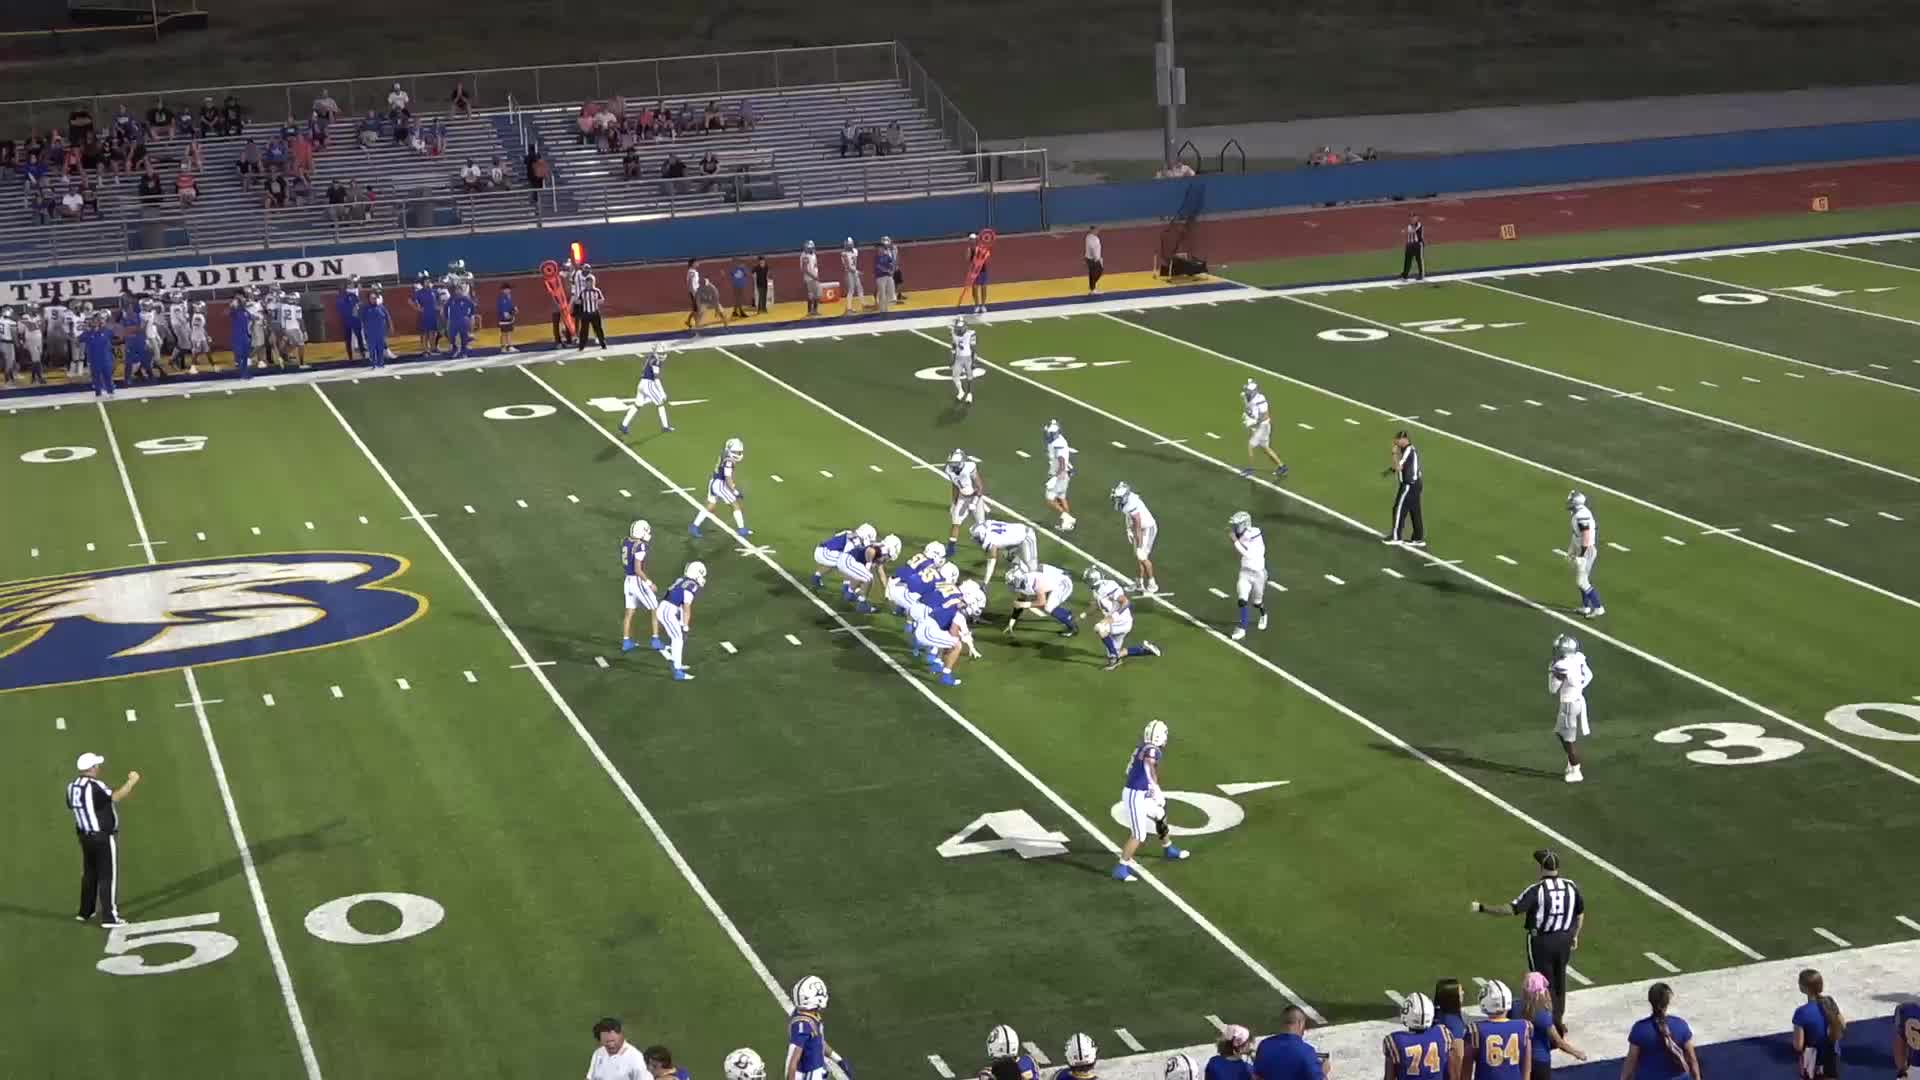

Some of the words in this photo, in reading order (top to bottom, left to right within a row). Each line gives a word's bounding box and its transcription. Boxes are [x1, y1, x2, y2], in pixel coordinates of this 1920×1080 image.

[10, 279, 92, 300] THE
[113, 258, 345, 293] TRADITION
[72, 786, 83, 807] R
[1549, 890, 1566, 914] H
[1405, 1042, 1440, 1076] 74
[1485, 1033, 1520, 1067] 64
